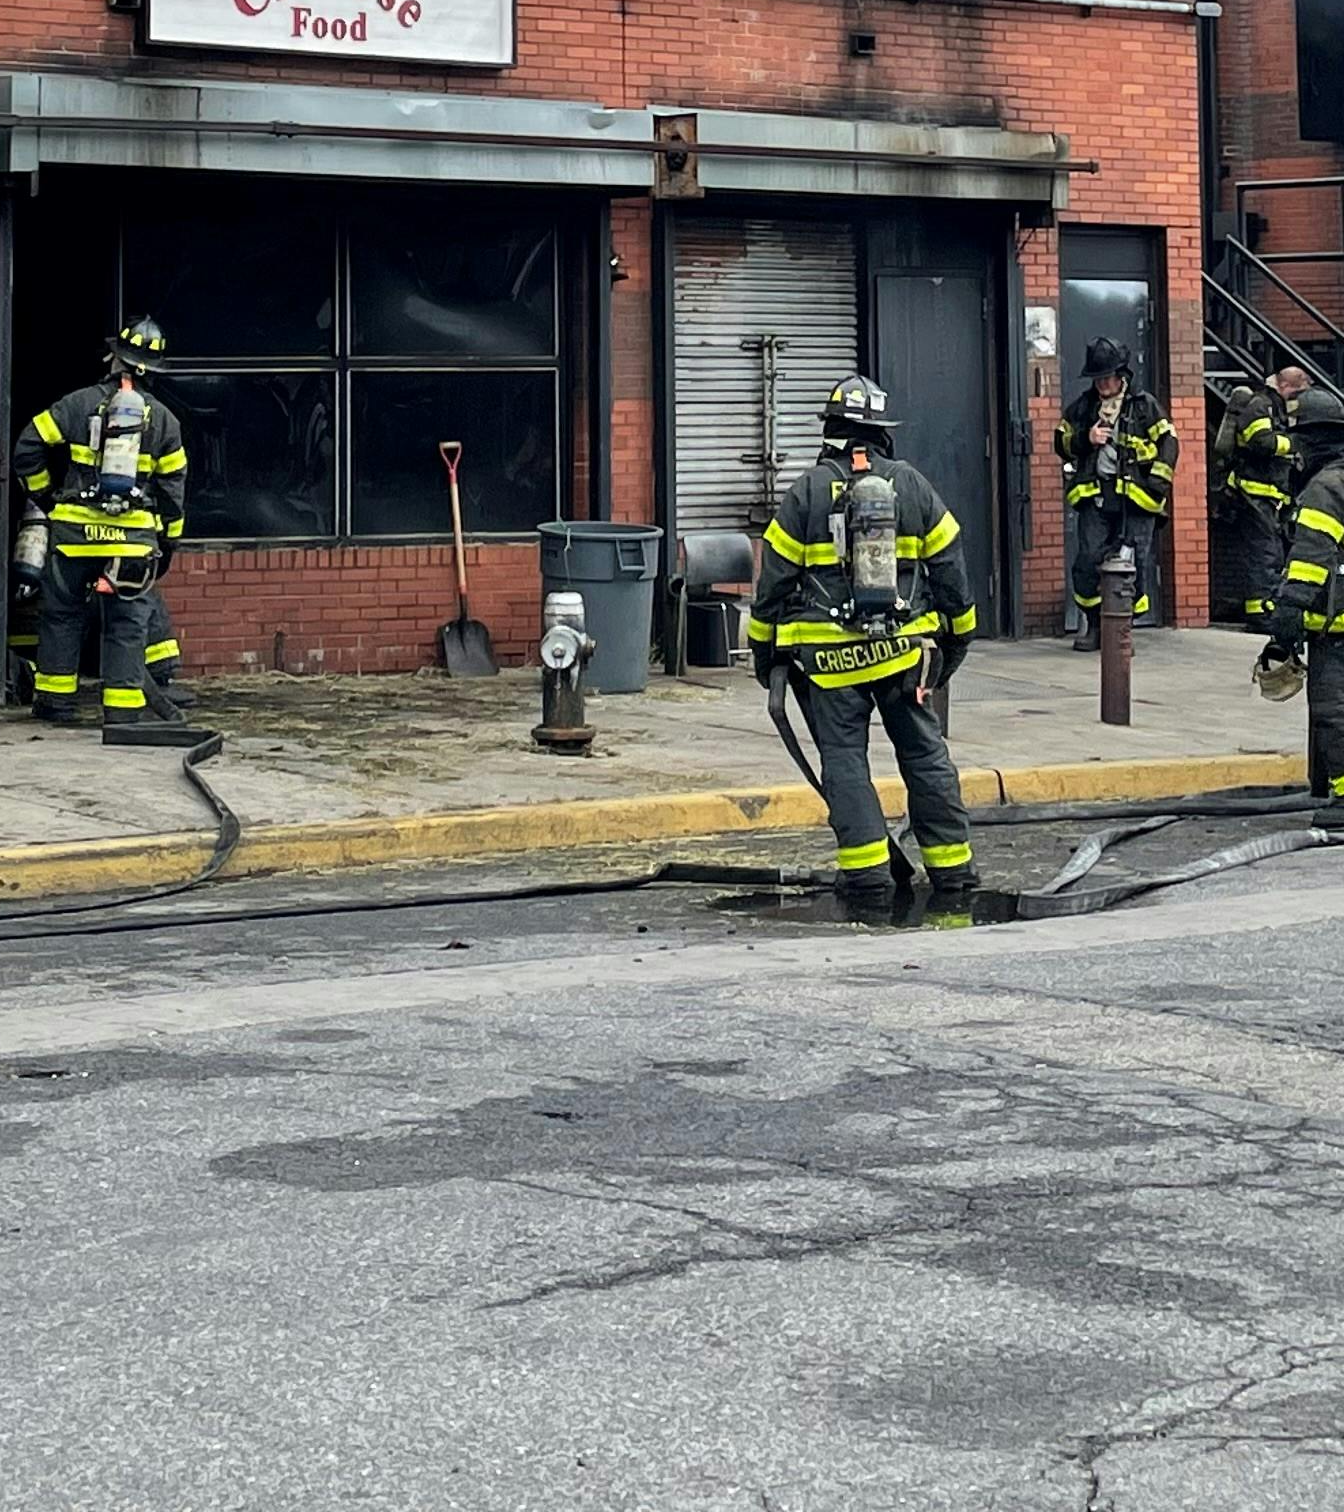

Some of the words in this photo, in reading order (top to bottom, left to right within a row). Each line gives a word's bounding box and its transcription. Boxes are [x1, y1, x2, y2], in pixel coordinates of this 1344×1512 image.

[290, 6, 368, 41] Food
[84, 524, 127, 541] DIXON
[815, 636, 911, 672] CRISCUOLO
